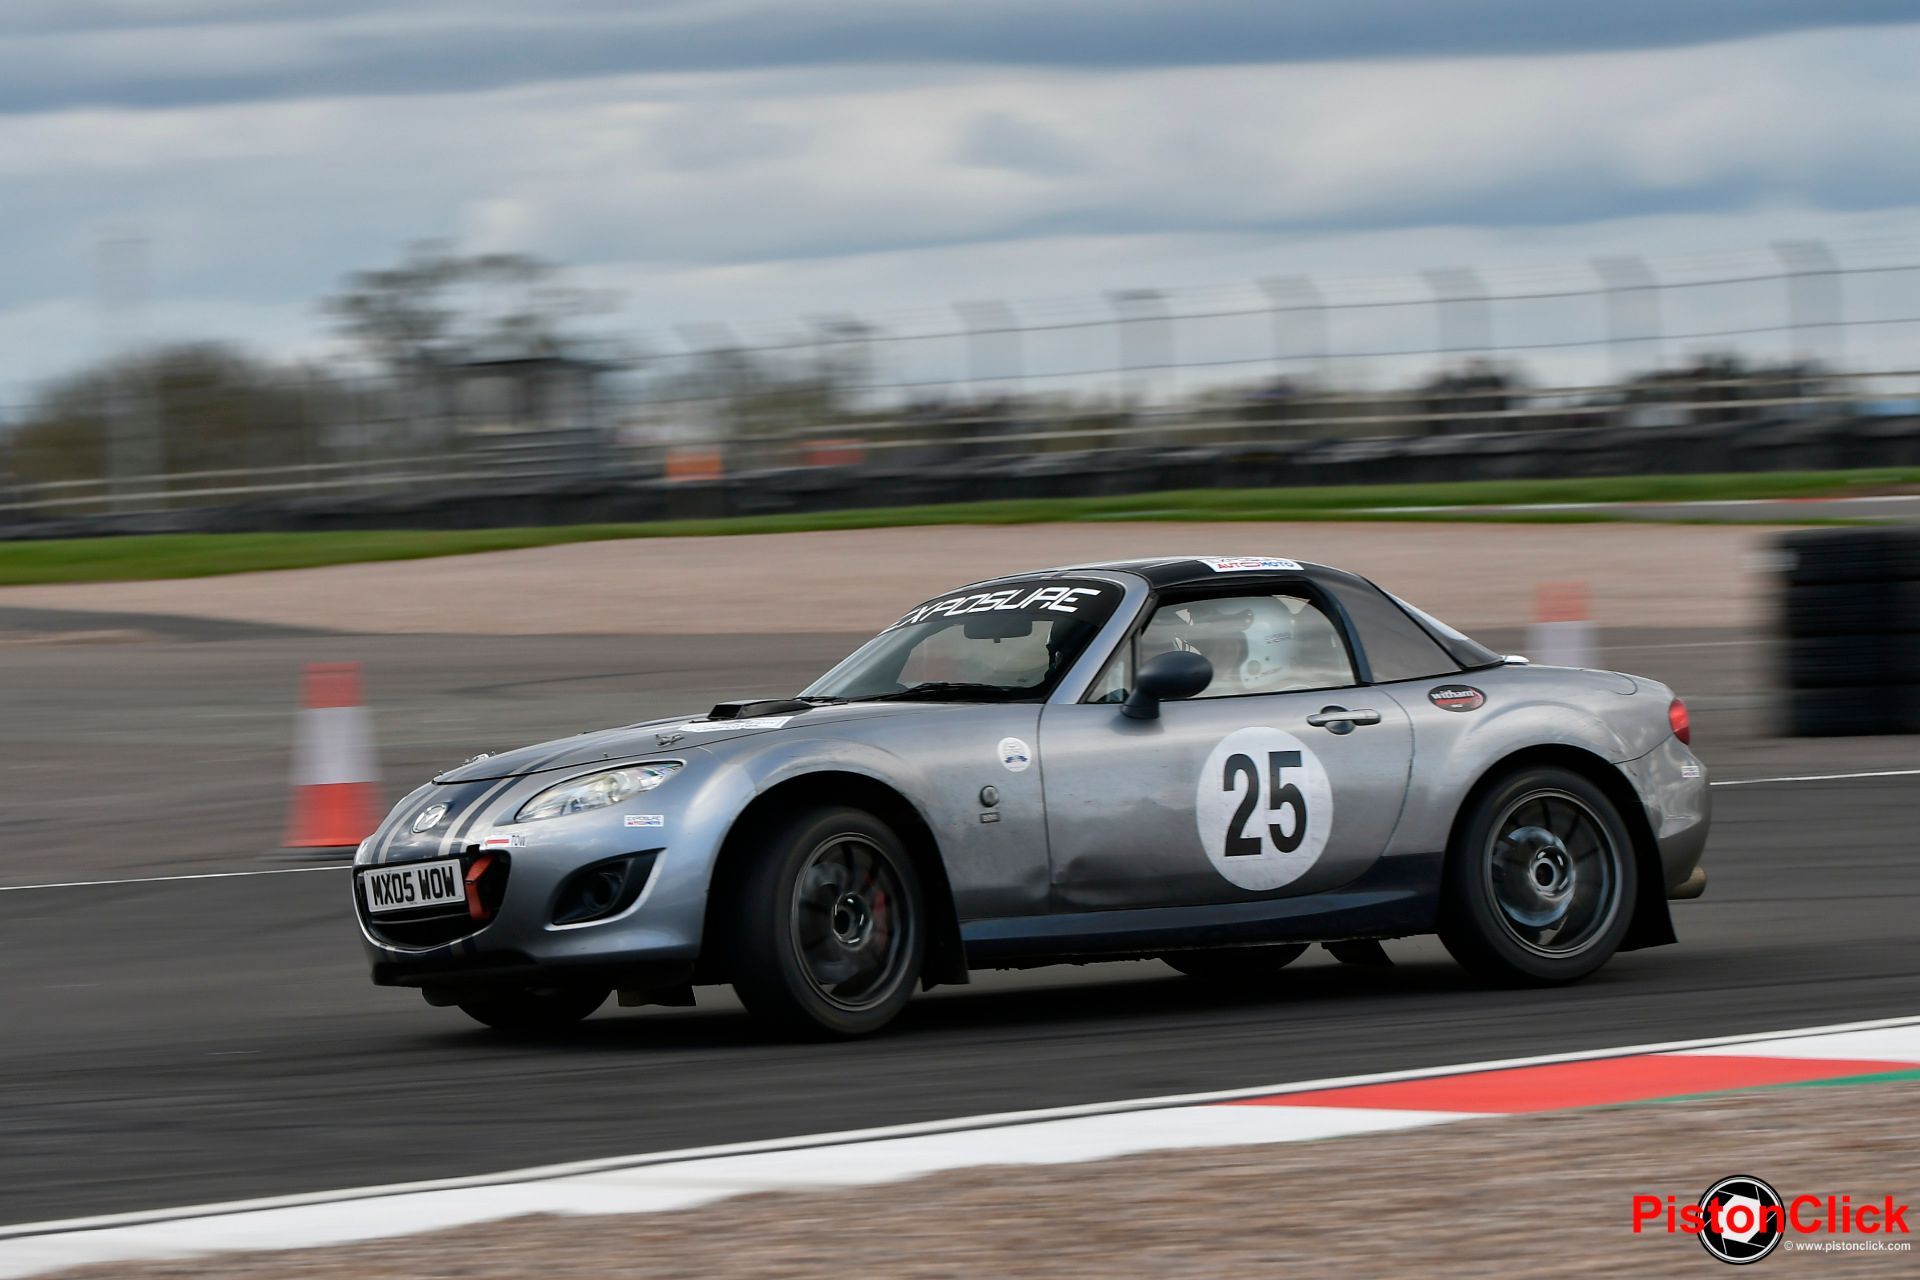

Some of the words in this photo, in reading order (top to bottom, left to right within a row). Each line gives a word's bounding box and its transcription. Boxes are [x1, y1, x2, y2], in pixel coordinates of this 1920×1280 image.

[877, 587, 1101, 636] EXPOSURE
[1431, 690, 1475, 699] witham
[1223, 750, 1307, 857] 25
[370, 871, 416, 906] MX05
[417, 865, 456, 900] WOW
